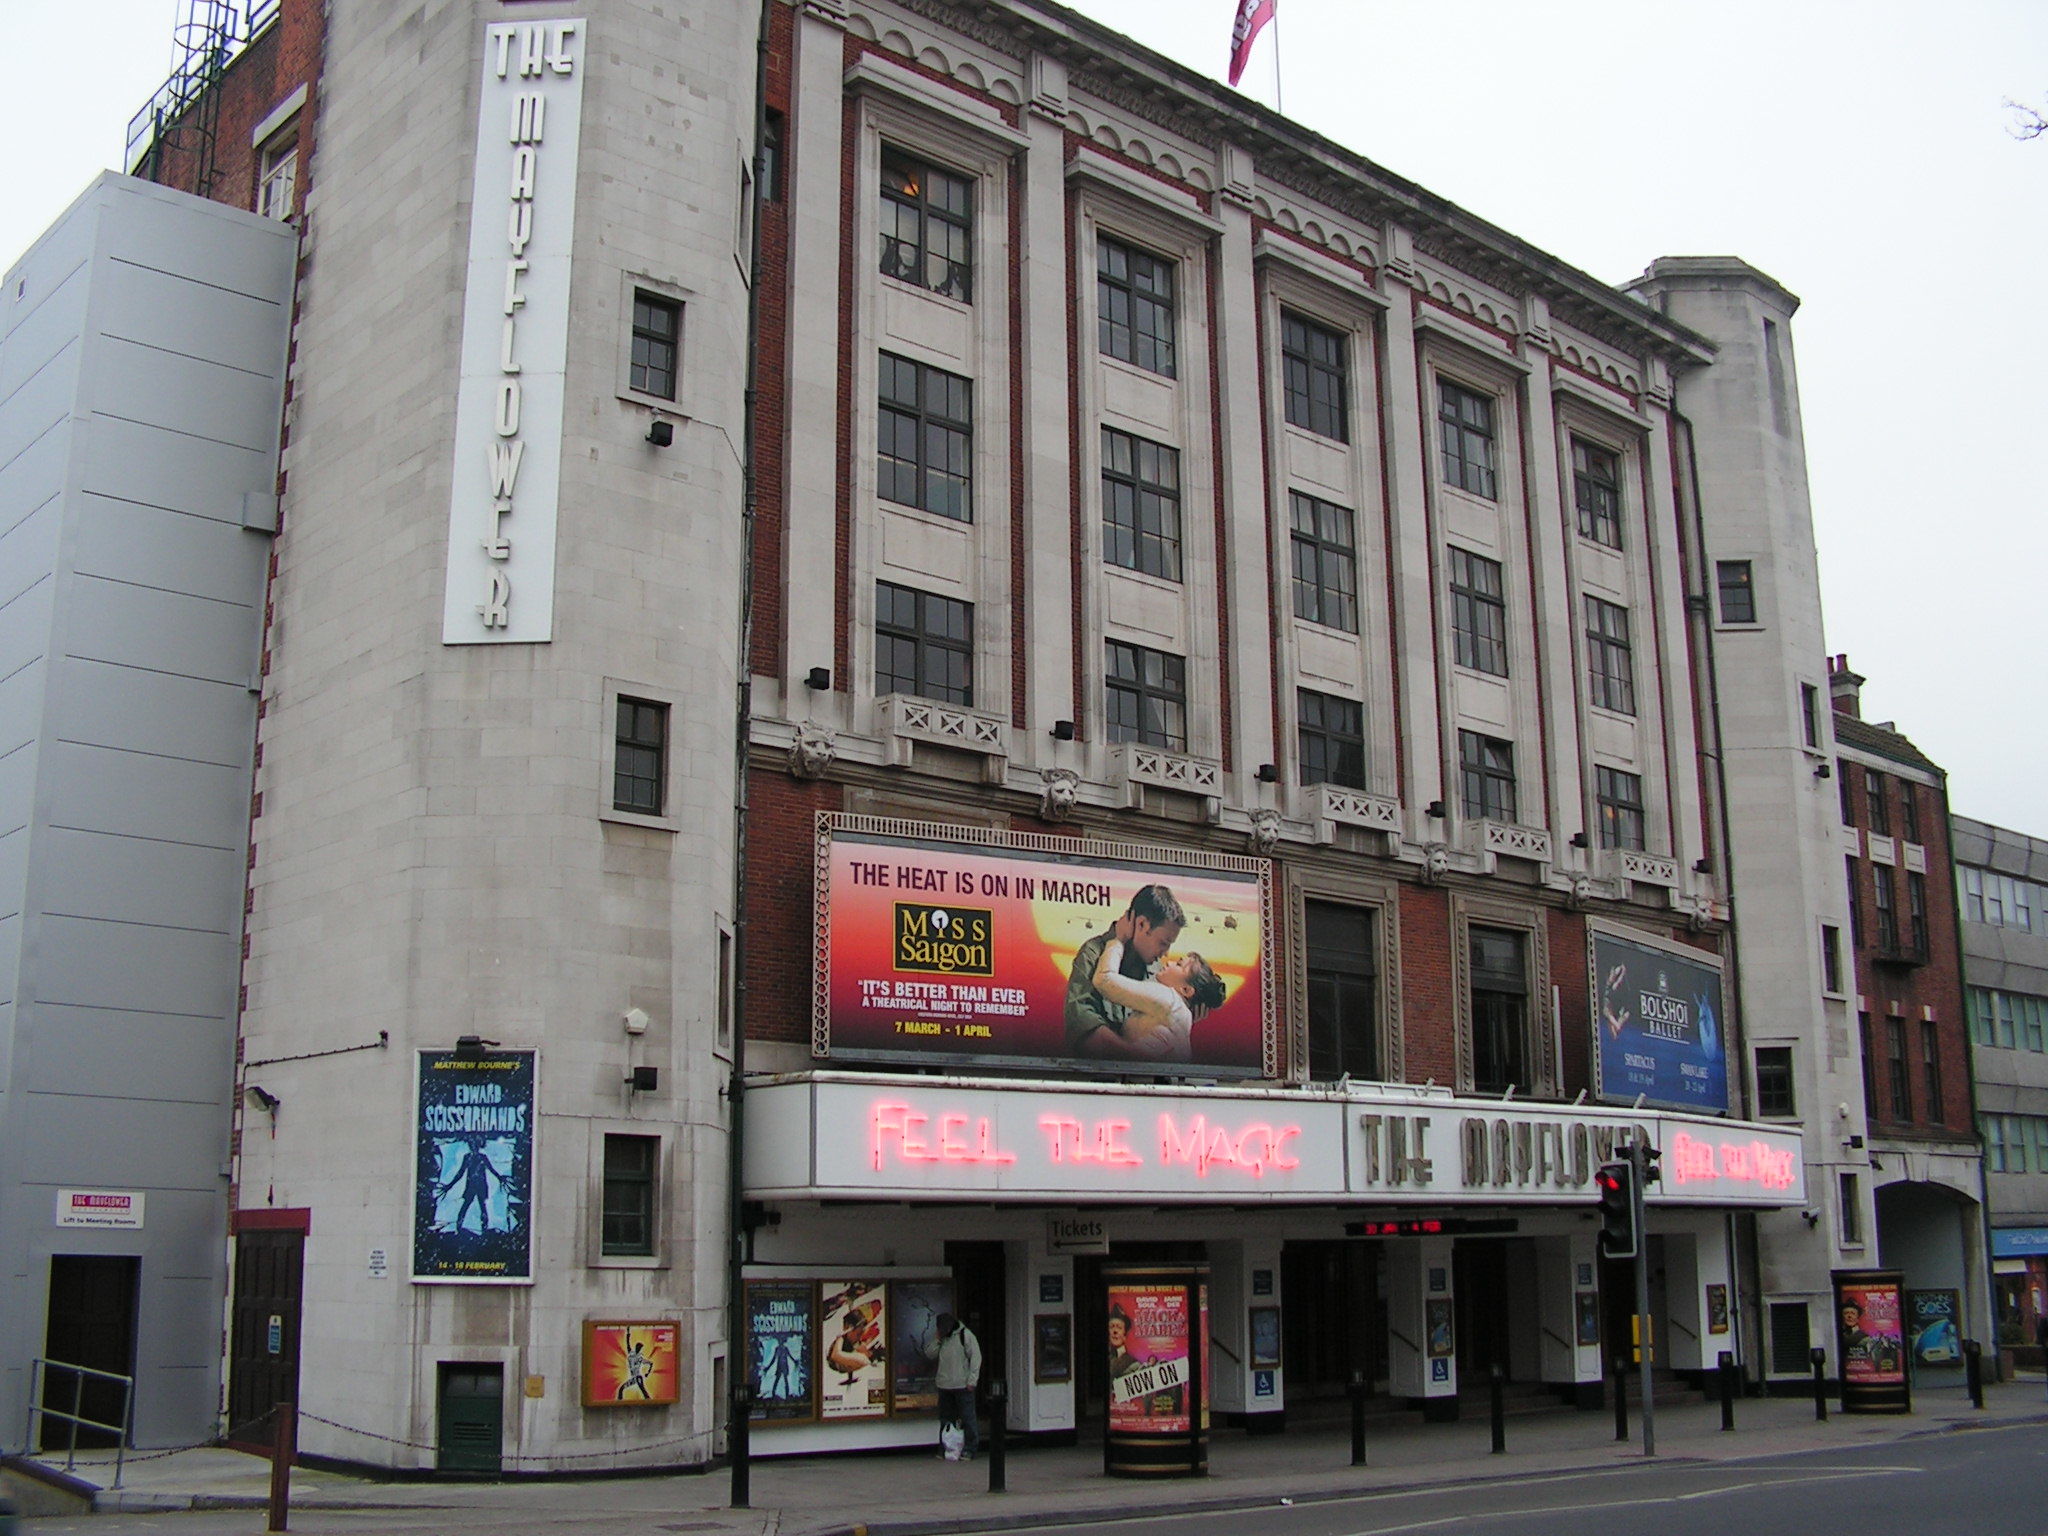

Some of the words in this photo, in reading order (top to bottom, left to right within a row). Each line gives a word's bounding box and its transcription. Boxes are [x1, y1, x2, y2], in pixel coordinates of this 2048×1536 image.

[493, 24, 575, 78] THE
[475, 90, 545, 628] MAYFLOWER
[850, 861, 889, 887] THE
[897, 866, 948, 892] HEAT
[956, 871, 974, 895] IS
[981, 874, 1008, 898] ON
[1015, 877, 1034, 900] IN
[1042, 880, 1111, 907] MARCH
[901, 935, 987, 971] Saigon
[862, 997, 870, 1007] A
[872, 998, 928, 1011] THEATRICAL
[931, 1001, 957, 1013] NIGHT
[960, 1003, 972, 1013] TO
[895, 982, 947, 999] BETTER
[950, 985, 987, 1002] THAN
[991, 988, 1026, 1004] EVER
[1641, 994, 1688, 1024] BOLSHOI
[894, 1022, 902, 1033] 7
[905, 1022, 941, 1035] MARCH
[955, 1024, 961, 1036] 1
[963, 1025, 992, 1037] APRIL
[1650, 1020, 1682, 1039] BALLET
[433, 1061, 476, 1070] MATTHEW
[455, 1082, 502, 1104] EDWARD
[425, 1103, 527, 1132] SCISSORHANDS
[873, 1103, 1017, 1172] FEEL
[1038, 1115, 1143, 1166] THE
[1159, 1113, 1302, 1178] MAGIC
[1360, 1114, 1433, 1186] THE
[1052, 1219, 1102, 1237] Tickets
[465, 1261, 506, 1270] FEBRUARY
[1916, 1302, 1951, 1313] GOES
[1124, 1370, 1154, 1397] NOW
[1158, 1363, 1179, 1386] ON
